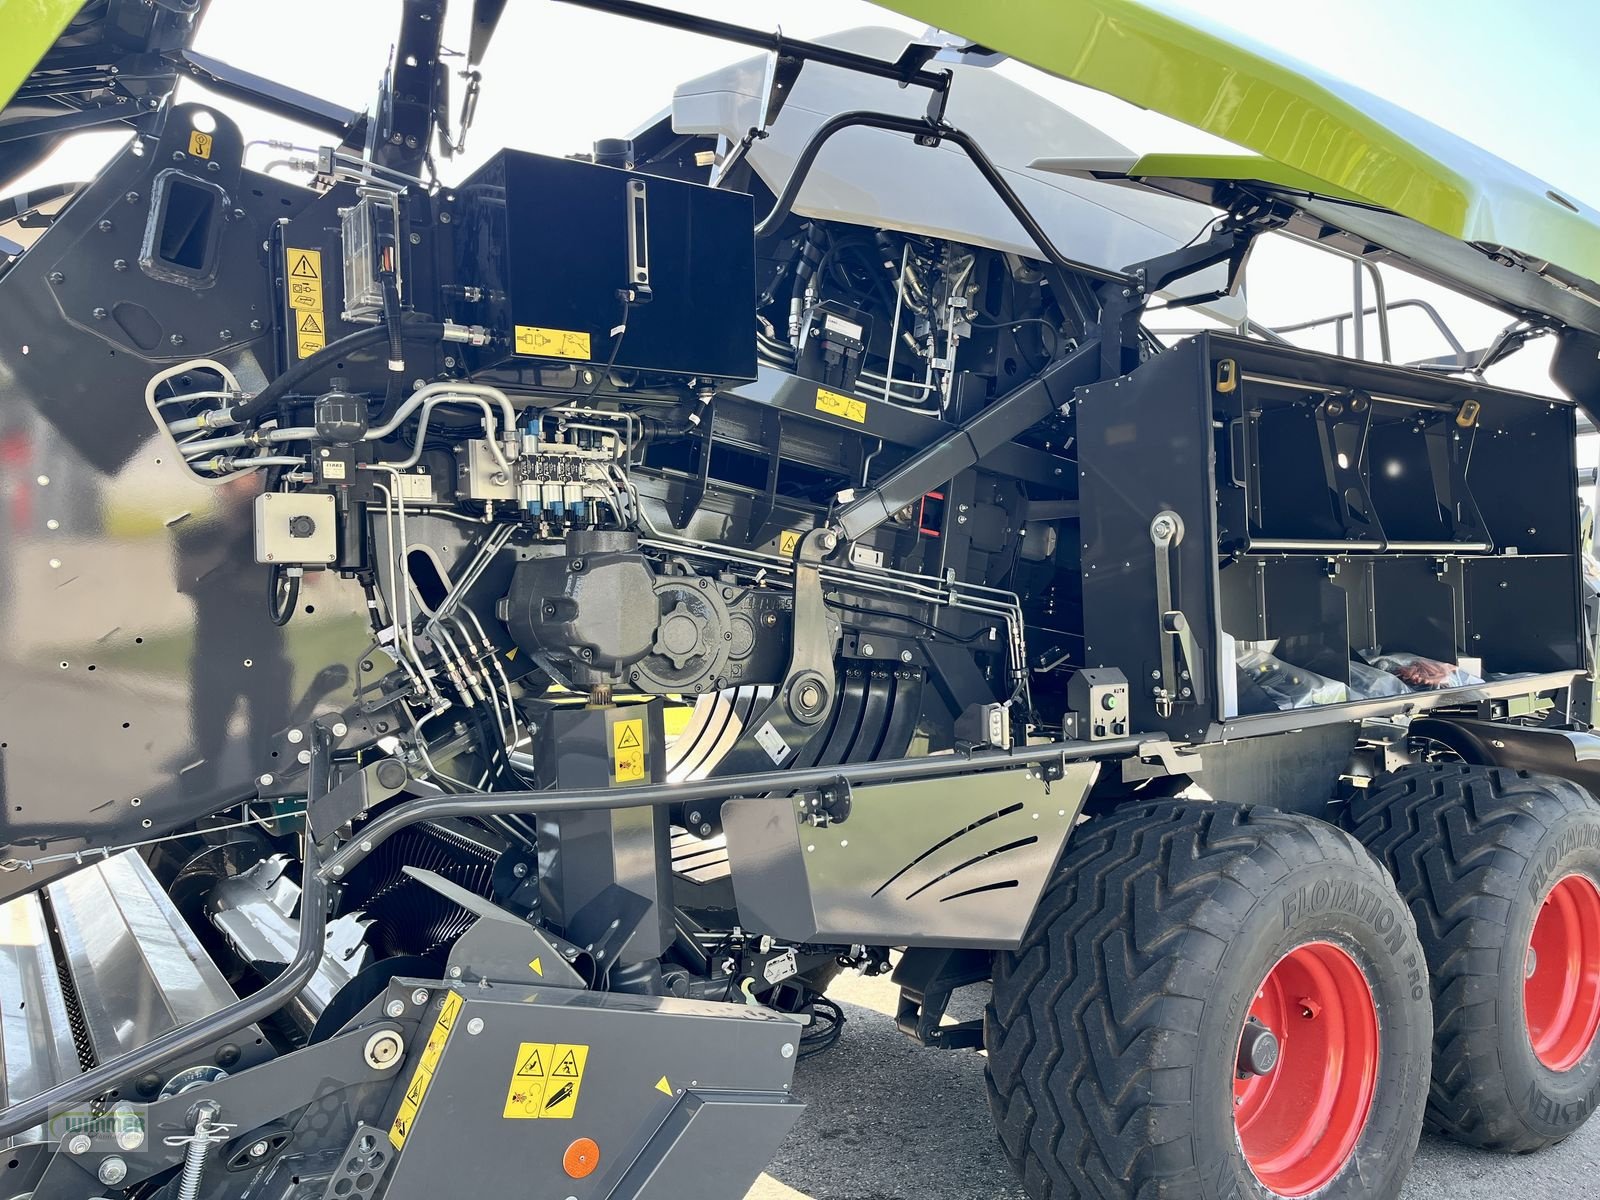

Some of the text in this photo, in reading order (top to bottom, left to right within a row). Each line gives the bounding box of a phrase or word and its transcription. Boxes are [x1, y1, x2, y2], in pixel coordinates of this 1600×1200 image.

[1528, 823, 1600, 905] FLOTATIO
[1281, 879, 1424, 1002] FLOTATION PRO
